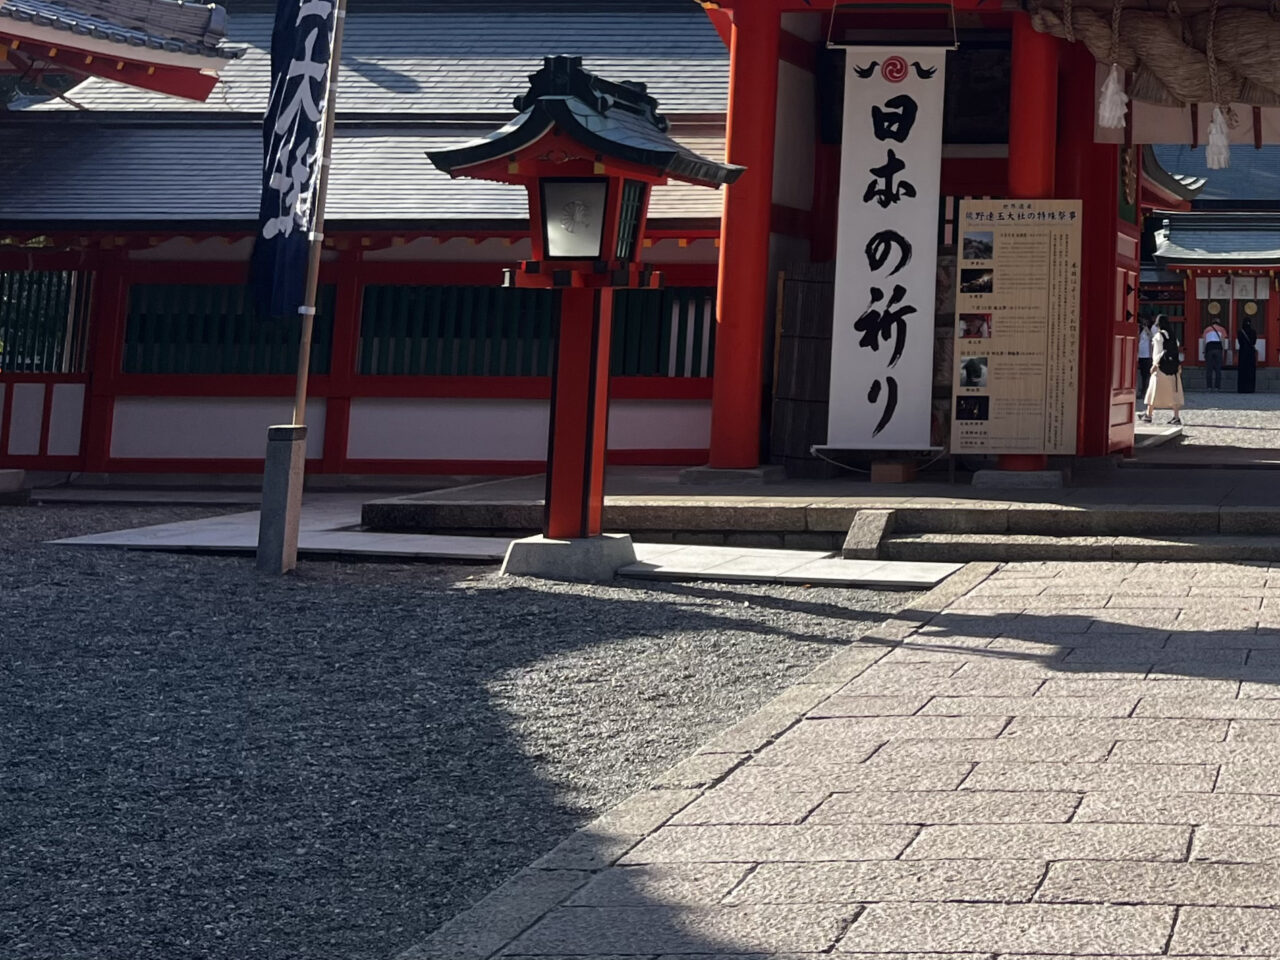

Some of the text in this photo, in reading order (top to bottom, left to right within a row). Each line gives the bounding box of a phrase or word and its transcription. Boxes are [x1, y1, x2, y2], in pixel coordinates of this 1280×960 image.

[853, 93, 918, 439] 日本の祈り
